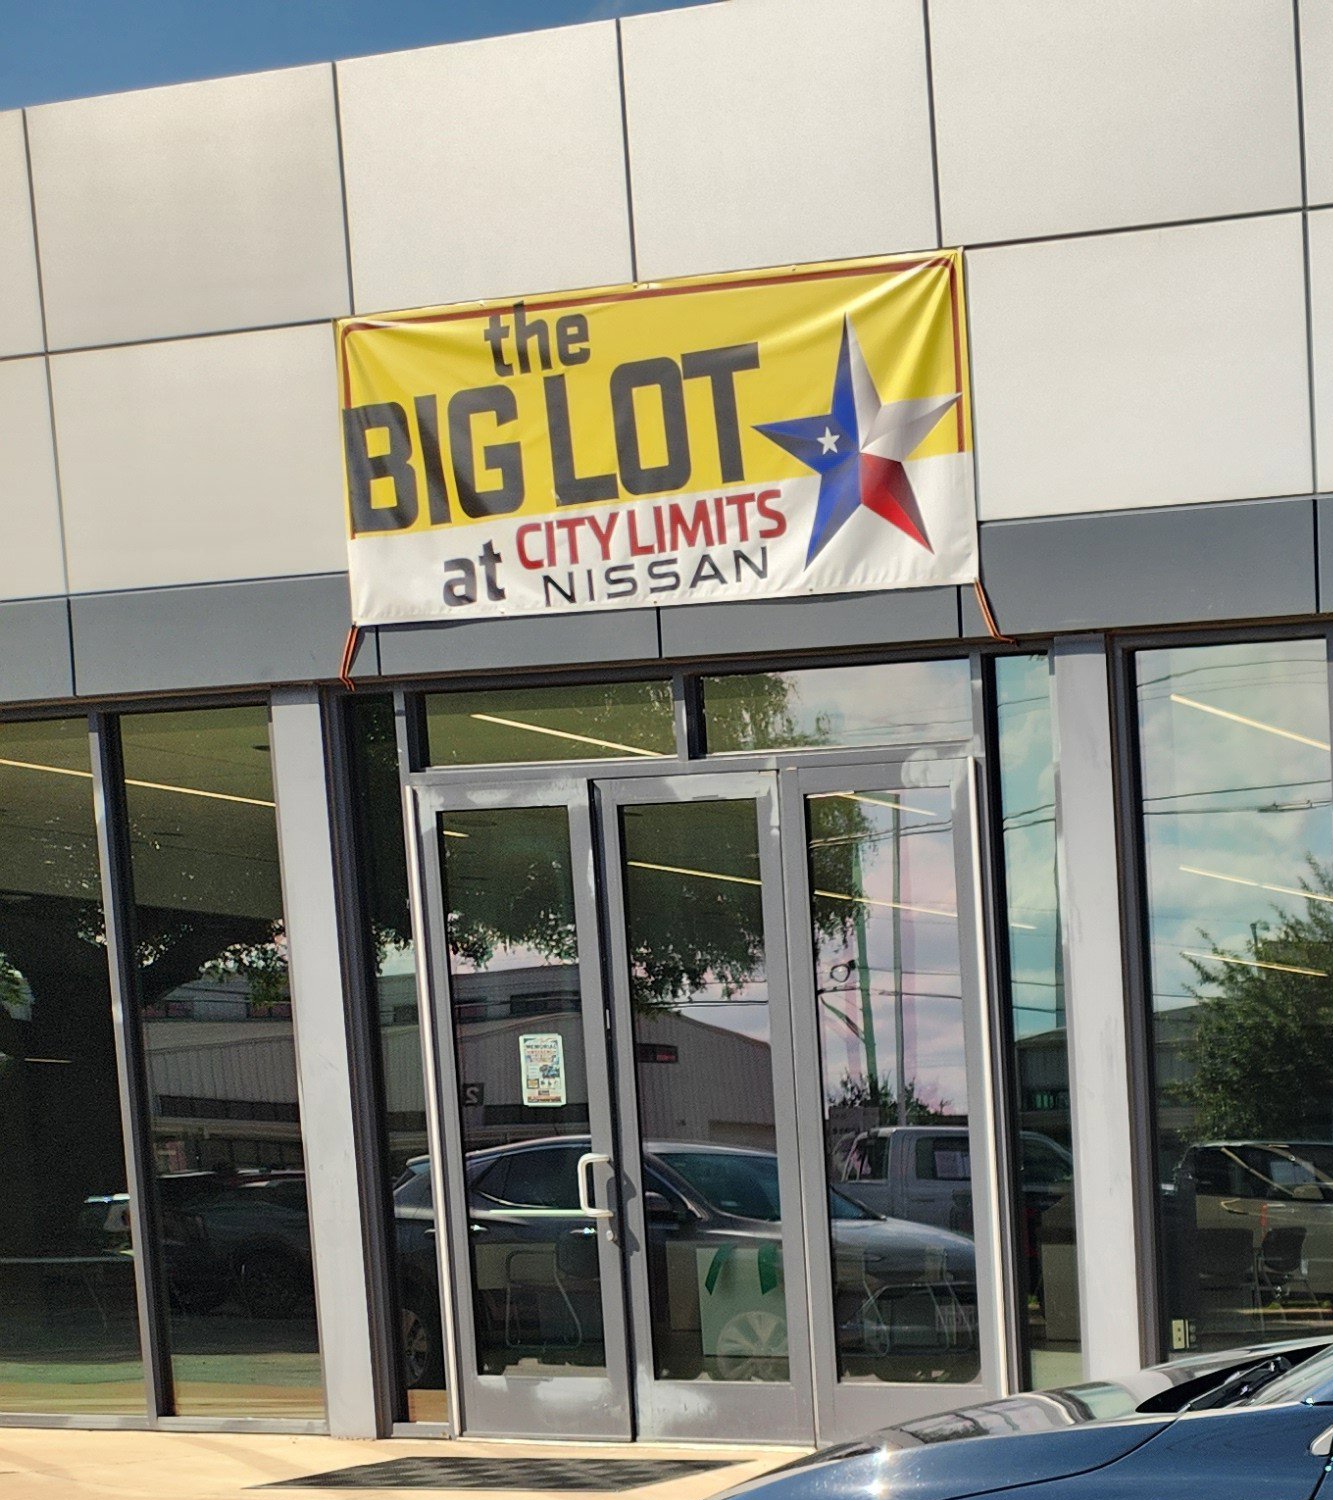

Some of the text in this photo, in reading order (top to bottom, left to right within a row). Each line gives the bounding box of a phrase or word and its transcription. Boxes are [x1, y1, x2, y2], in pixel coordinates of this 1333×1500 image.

[483, 300, 592, 378] the
[342, 341, 761, 533] BIG LOT
[515, 488, 788, 571] CITY LIMITS
[441, 539, 509, 608] at
[543, 546, 769, 607] NISSAN
